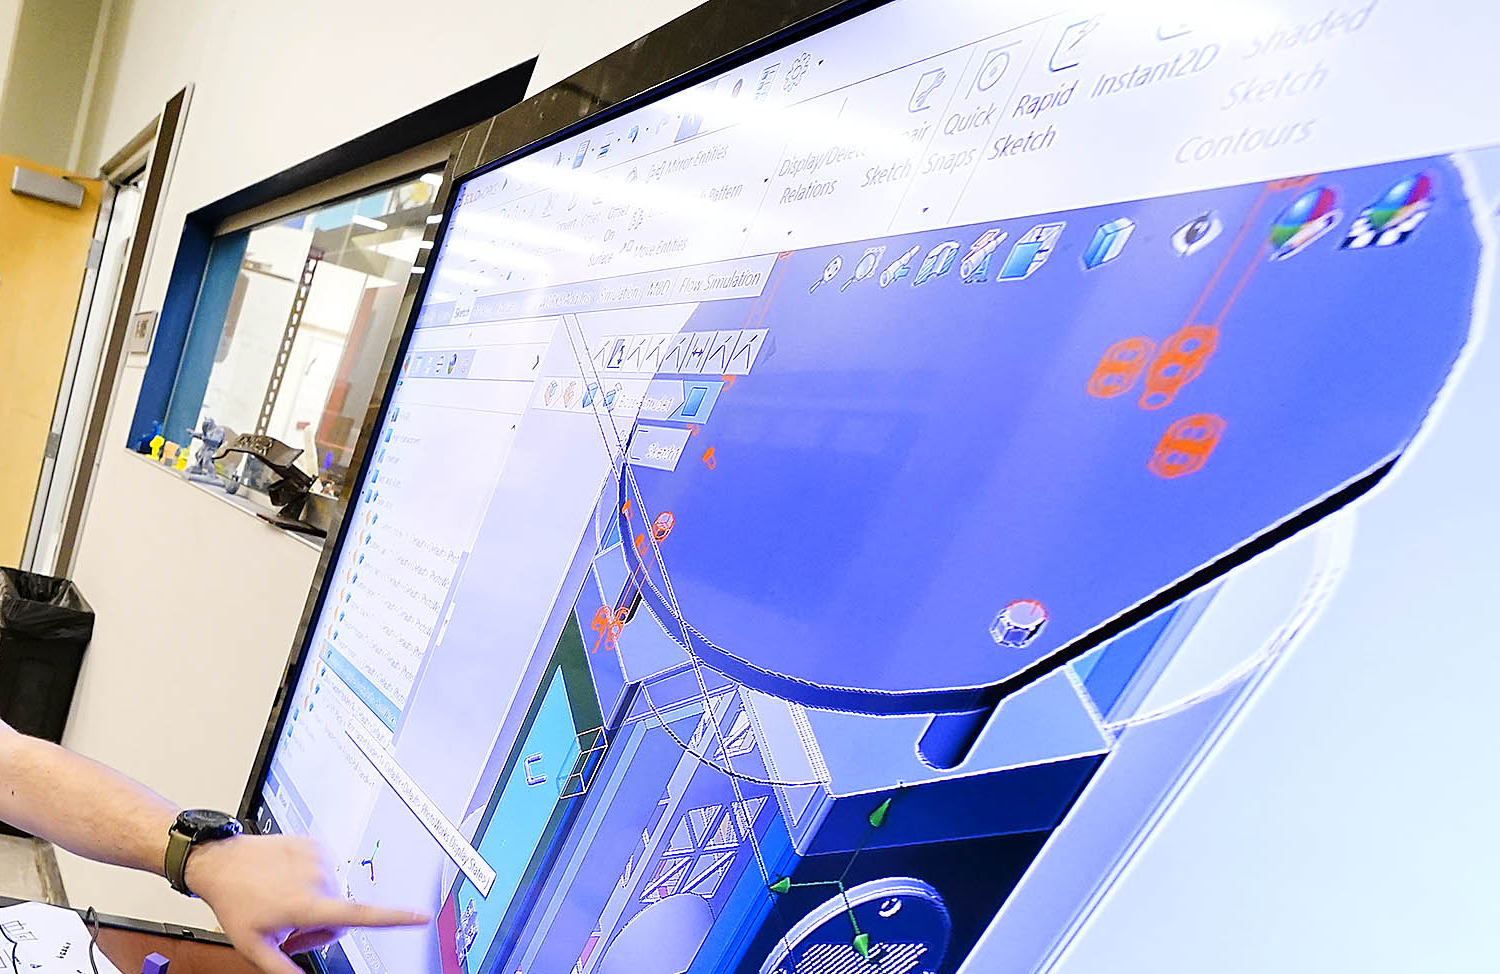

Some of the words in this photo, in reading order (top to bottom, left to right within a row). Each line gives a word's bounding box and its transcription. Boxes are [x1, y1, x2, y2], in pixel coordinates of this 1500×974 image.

[1090, 43, 1220, 99] Instant2D
[1220, 59, 1329, 111] Sketch
[1012, 80, 1080, 121] Rapid
[944, 102, 997, 136] Quick
[987, 125, 1056, 161] Sketch
[1174, 117, 1319, 164] Contours
[861, 159, 912, 189] Sketch
[921, 147, 977, 176] Snaps
[779, 180, 838, 205] Relations
[679, 276, 703, 294] Flow
[704, 268, 762, 292] Simulation
